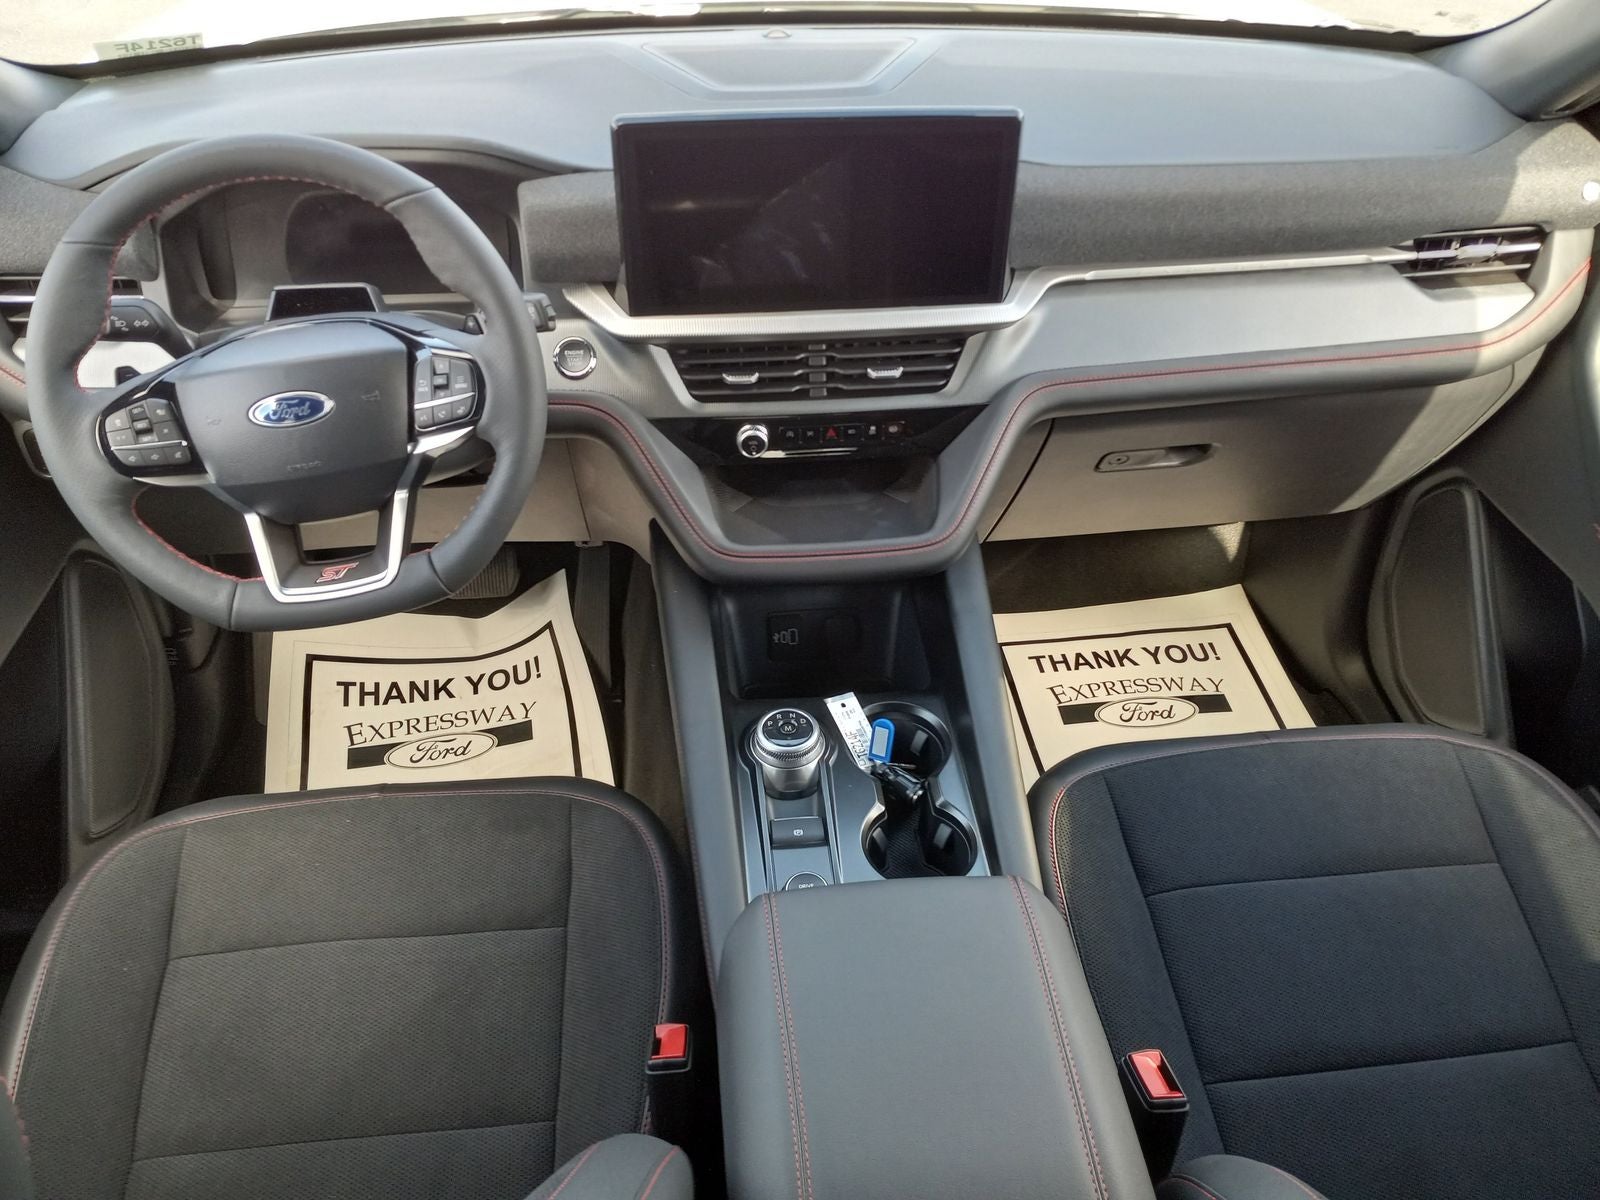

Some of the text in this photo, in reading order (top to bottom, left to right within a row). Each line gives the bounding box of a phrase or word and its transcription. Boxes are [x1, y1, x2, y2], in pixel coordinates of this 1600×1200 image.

[269, 399, 312, 419] Ford
[316, 561, 360, 583] ST
[1028, 642, 1221, 674] THANK YOU!
[336, 655, 542, 707] THANK YOU!
[1046, 676, 1225, 705] EXPRESSWAY
[343, 701, 537, 747] EXPRESSWAY
[1119, 701, 1176, 723] Ford
[409, 737, 473, 764] Ford
